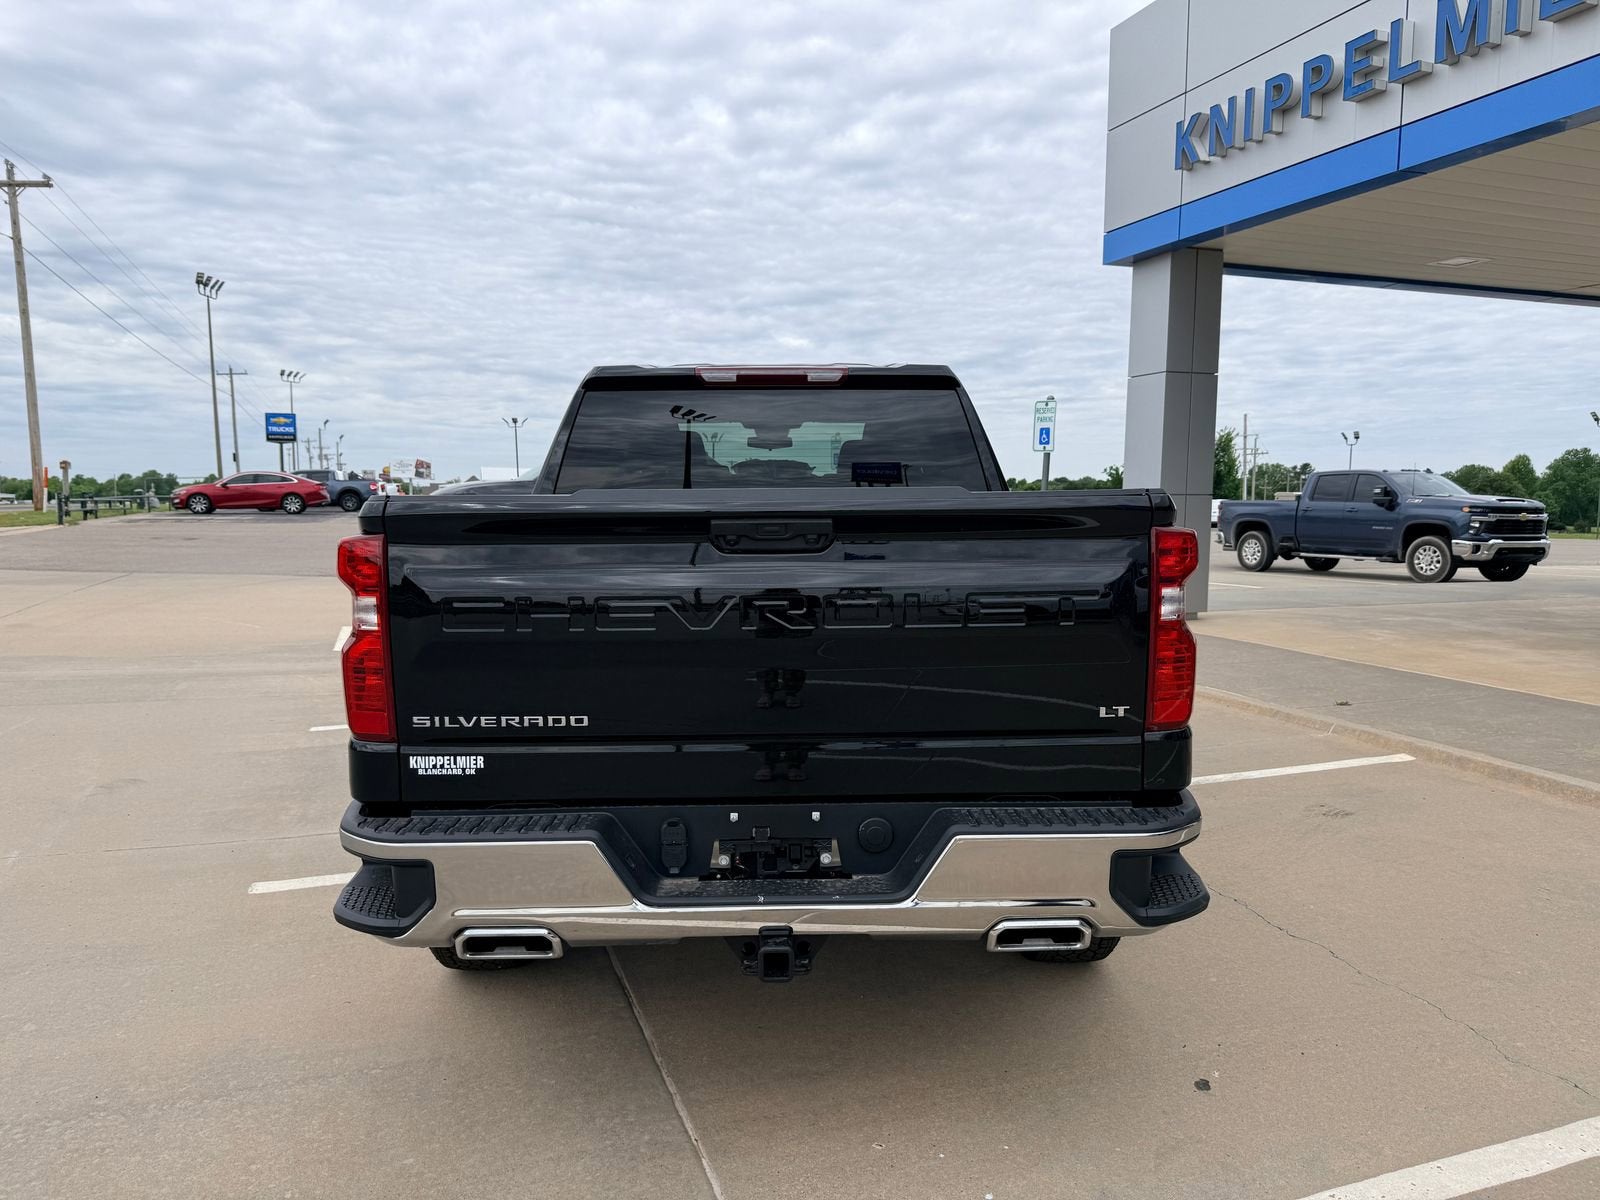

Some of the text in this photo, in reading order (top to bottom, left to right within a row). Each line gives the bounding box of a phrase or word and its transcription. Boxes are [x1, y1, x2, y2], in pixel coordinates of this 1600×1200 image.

[1174, 0, 1598, 171] KNIPPELM
[440, 590, 1100, 632] CHEVROLET
[1099, 706, 1130, 717] LT
[412, 715, 590, 728] SILVERADO
[409, 755, 485, 769] KNIPPELMIER
[418, 768, 465, 776] BLANCHARD,
